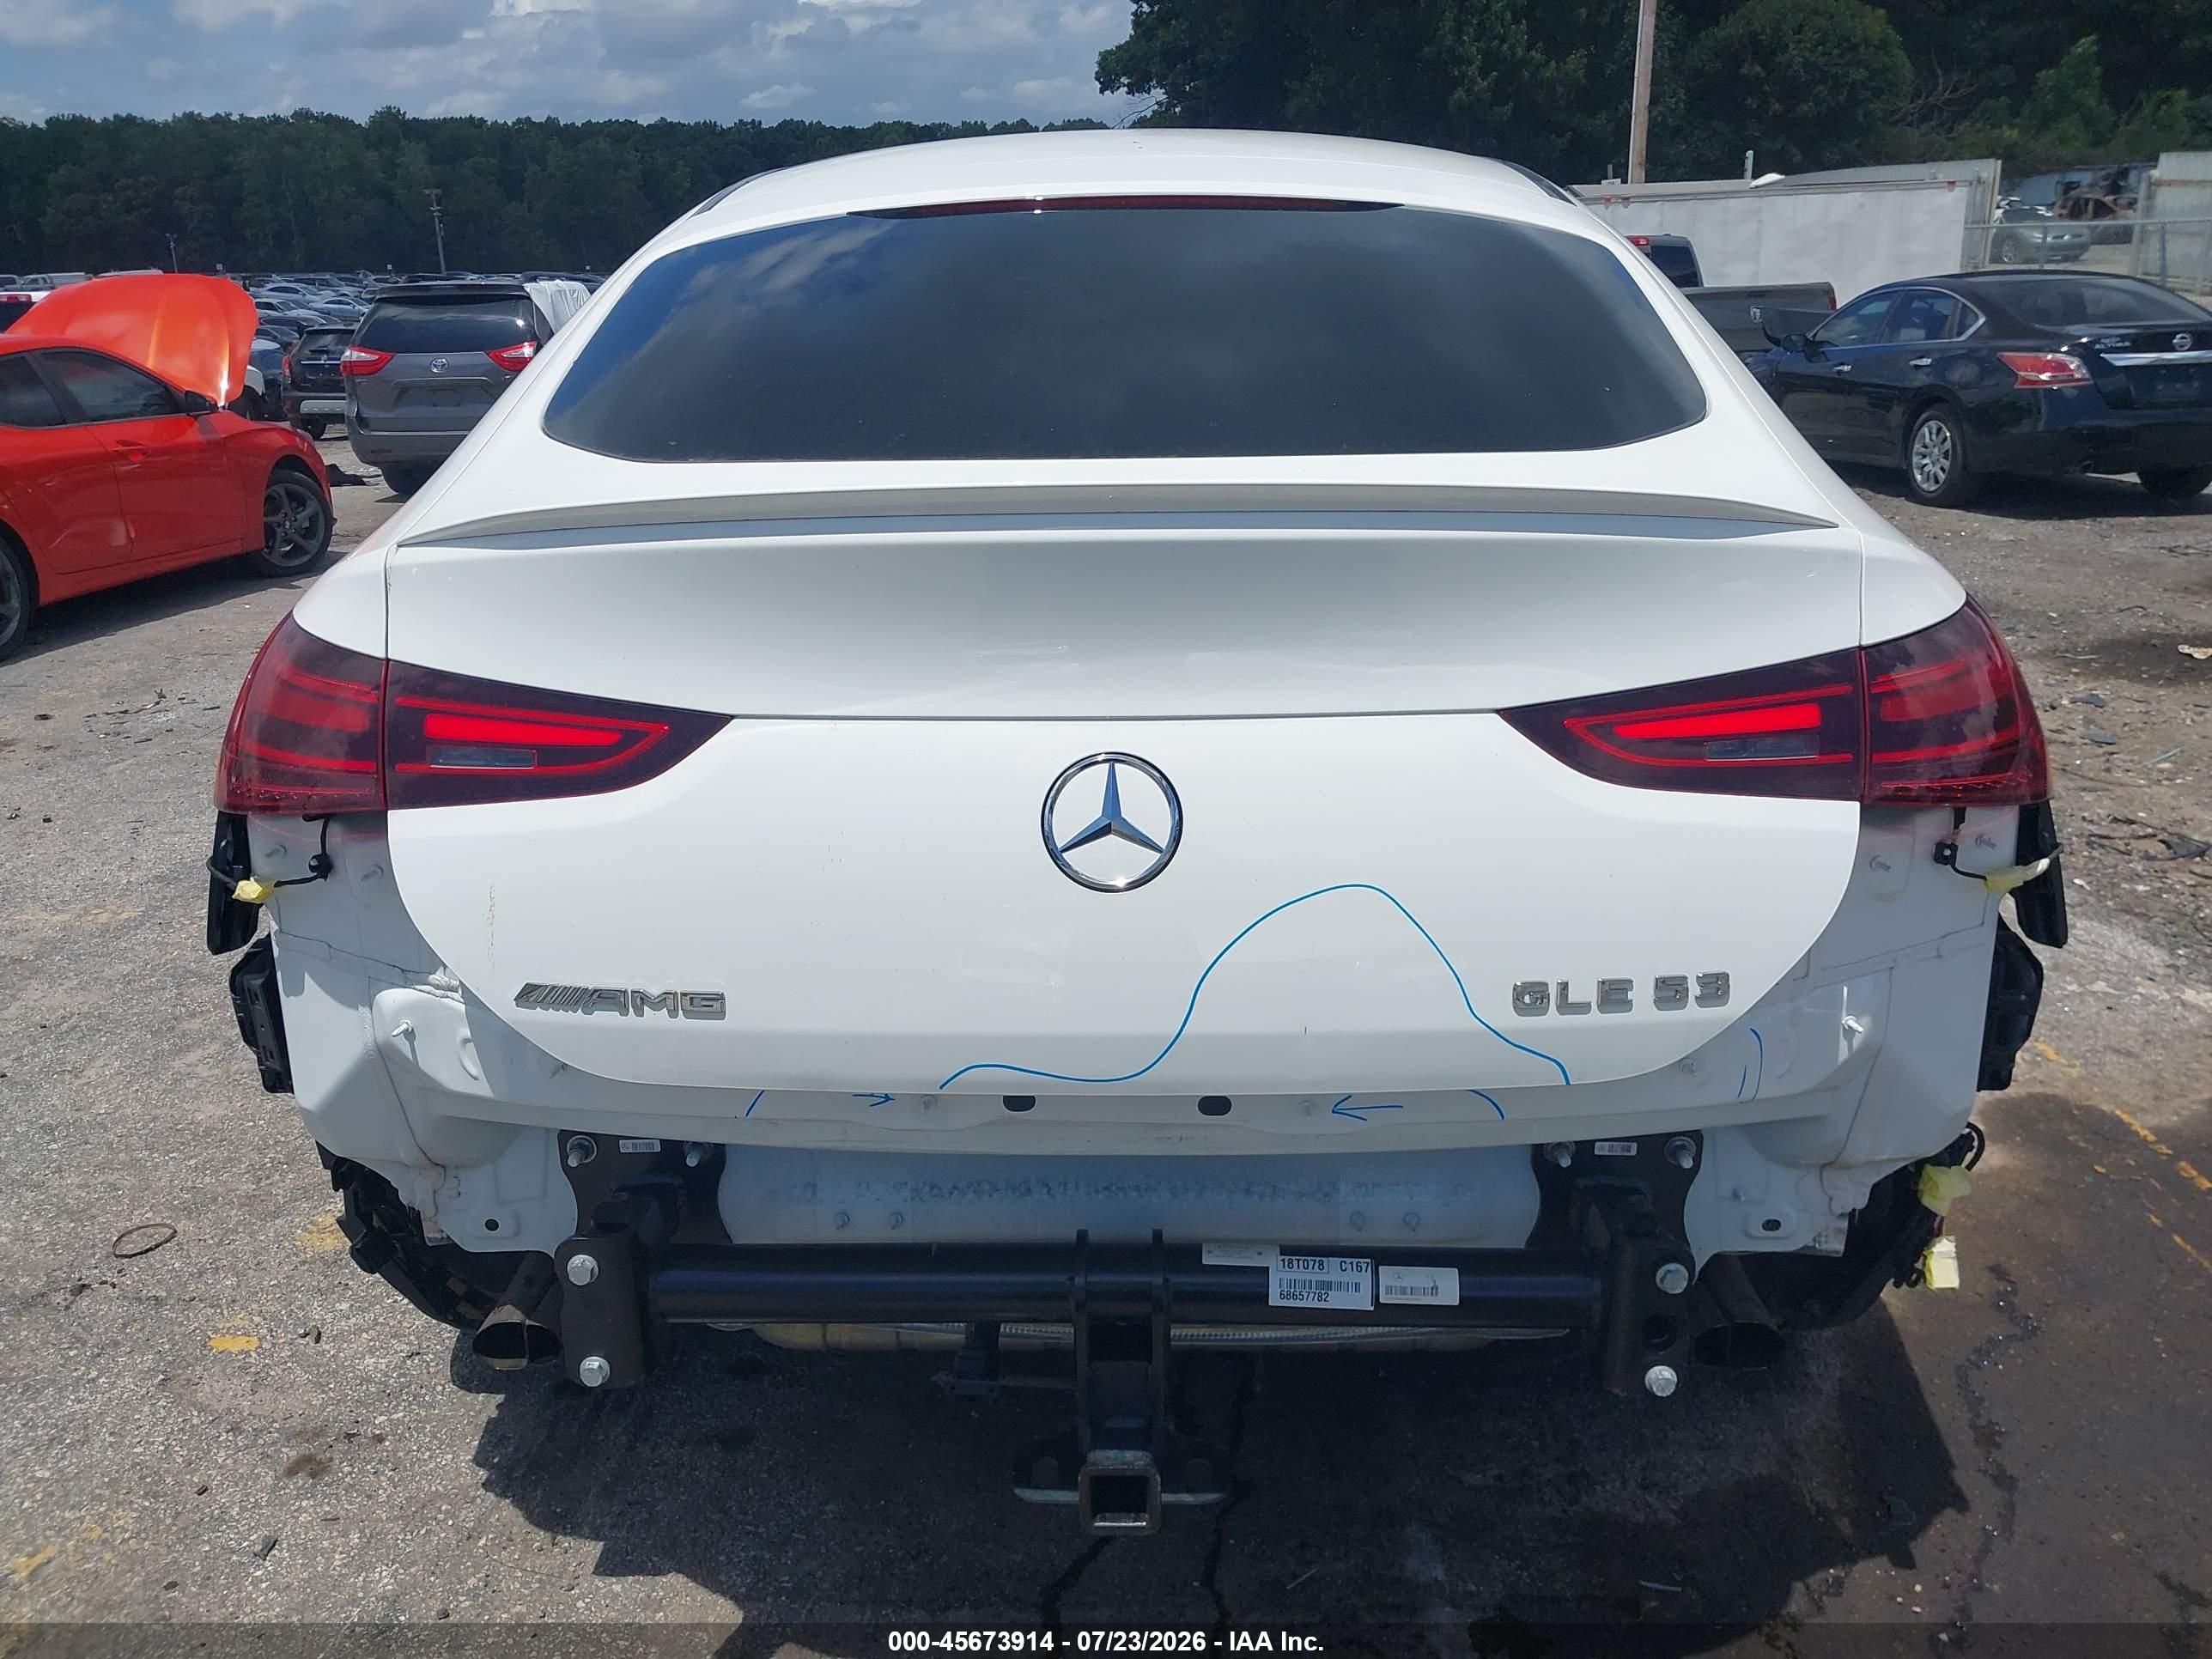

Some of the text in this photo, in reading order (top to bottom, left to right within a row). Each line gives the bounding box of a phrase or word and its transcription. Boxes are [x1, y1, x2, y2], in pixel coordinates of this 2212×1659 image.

[581, 987, 726, 1020] AMG
[1512, 971, 1730, 1017] GLE 53
[1279, 1257, 1370, 1273] 18T078 C167
[1279, 1289, 1329, 1303] 68657782
